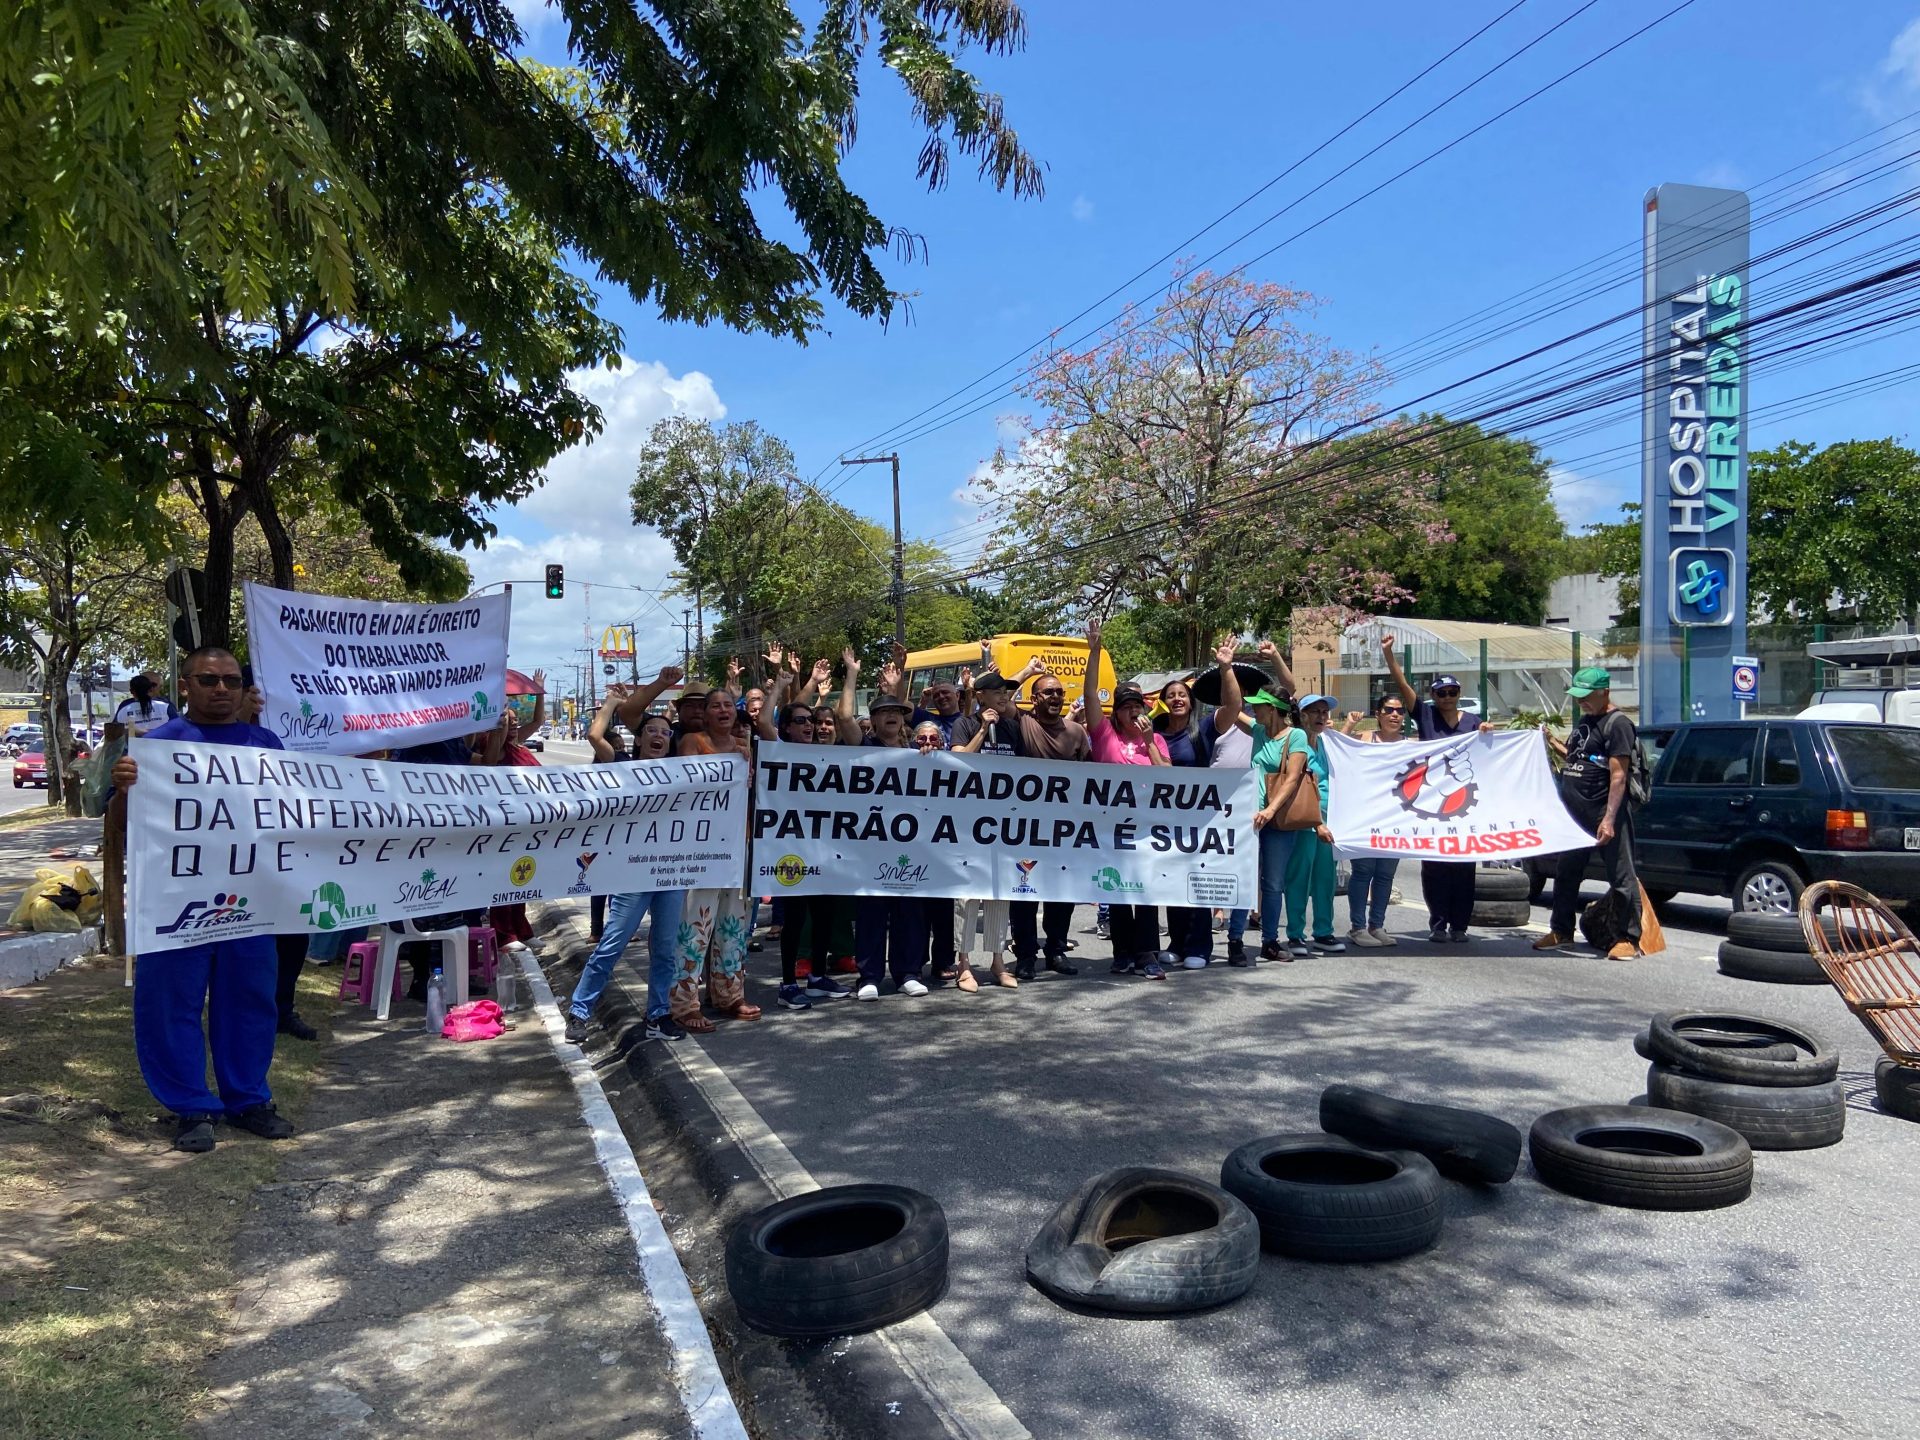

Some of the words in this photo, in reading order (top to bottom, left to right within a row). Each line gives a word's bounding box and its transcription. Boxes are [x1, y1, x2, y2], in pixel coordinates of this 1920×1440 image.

[1669, 275, 1706, 532] HOSPITAL
[1705, 275, 1741, 532] VEREDAS
[280, 605, 366, 636] PAGAMENTO
[370, 614, 392, 636] EM
[392, 614, 416, 635] DIA
[418, 608, 432, 634] É
[428, 608, 480, 633] DIREITO
[324, 644, 346, 667] DO
[348, 642, 450, 668] TRABALHADOR
[290, 674, 315, 694] SE
[312, 670, 347, 695] NÃO
[347, 674, 397, 695] PAGAR
[397, 669, 442, 692] VAMOS
[445, 662, 486, 687] PARAR!
[1043, 666, 1086, 676] SCOLA
[279, 712, 339, 738] SINEAL
[342, 712, 404, 732] SINDICATOS
[404, 712, 416, 726] DA
[414, 702, 470, 724] ENFERMAGEM
[172, 753, 342, 790] SALÁRIO
[362, 768, 384, 792] E
[401, 770, 621, 795] COMPLEMENTO
[632, 766, 672, 786] DO
[682, 761, 733, 783] PISO
[760, 761, 1070, 803] TRABALHADOR
[1083, 778, 1137, 809] NA
[1150, 783, 1233, 818] RUA,
[174, 798, 235, 831] DA
[254, 798, 490, 829] ENFERMAGEM
[498, 800, 517, 826] É
[524, 801, 568, 824] UM
[577, 794, 668, 820] DIREITO
[669, 792, 687, 811] E
[690, 790, 730, 811] TEM
[754, 806, 919, 842] PATRÃO
[931, 815, 958, 843] A
[972, 816, 1099, 849] CULPA
[1114, 818, 1137, 850] É
[1150, 825, 1235, 855] SUA!
[1370, 818, 1536, 835] MOVIMENTO
[1413, 837, 1435, 849] DE
[1438, 829, 1542, 855] CLASSES
[171, 841, 295, 877] QUE
[338, 837, 436, 865] SER
[760, 866, 821, 876] SINTRAEAL
[874, 862, 930, 882] SINEAL
[393, 876, 459, 904] SINEAL
[492, 889, 543, 903] SINTRAEAL
[568, 885, 592, 894] SINDFAL
